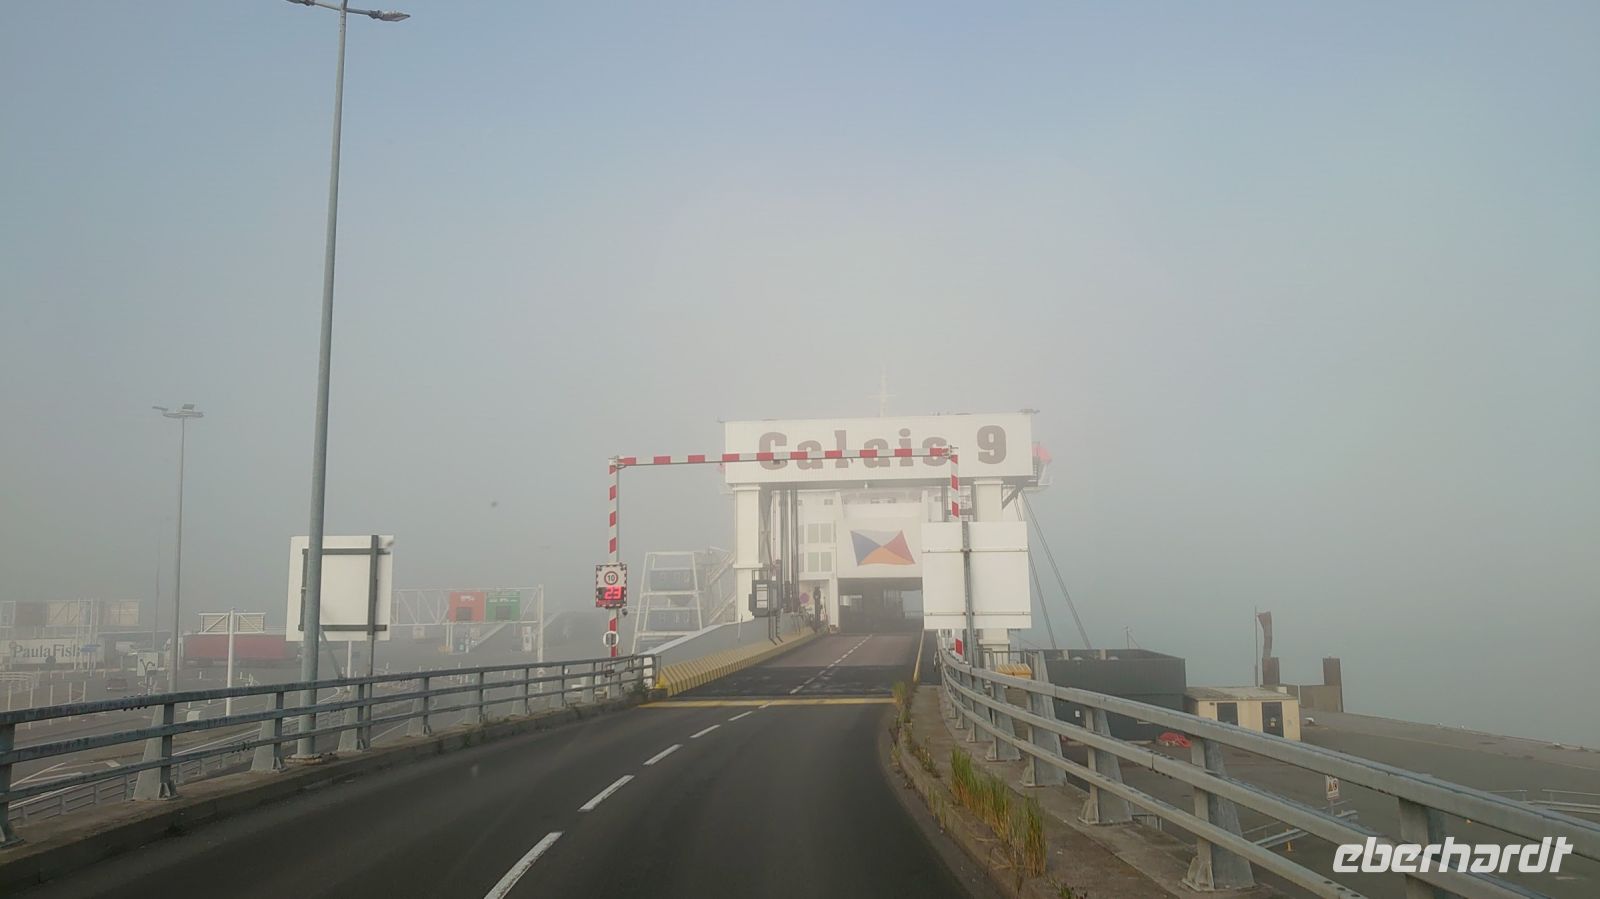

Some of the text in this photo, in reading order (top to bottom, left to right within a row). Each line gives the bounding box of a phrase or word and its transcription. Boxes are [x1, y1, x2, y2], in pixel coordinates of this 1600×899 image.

[758, 425, 1006, 470] Calais 9
[605, 585, 622, 599] 23
